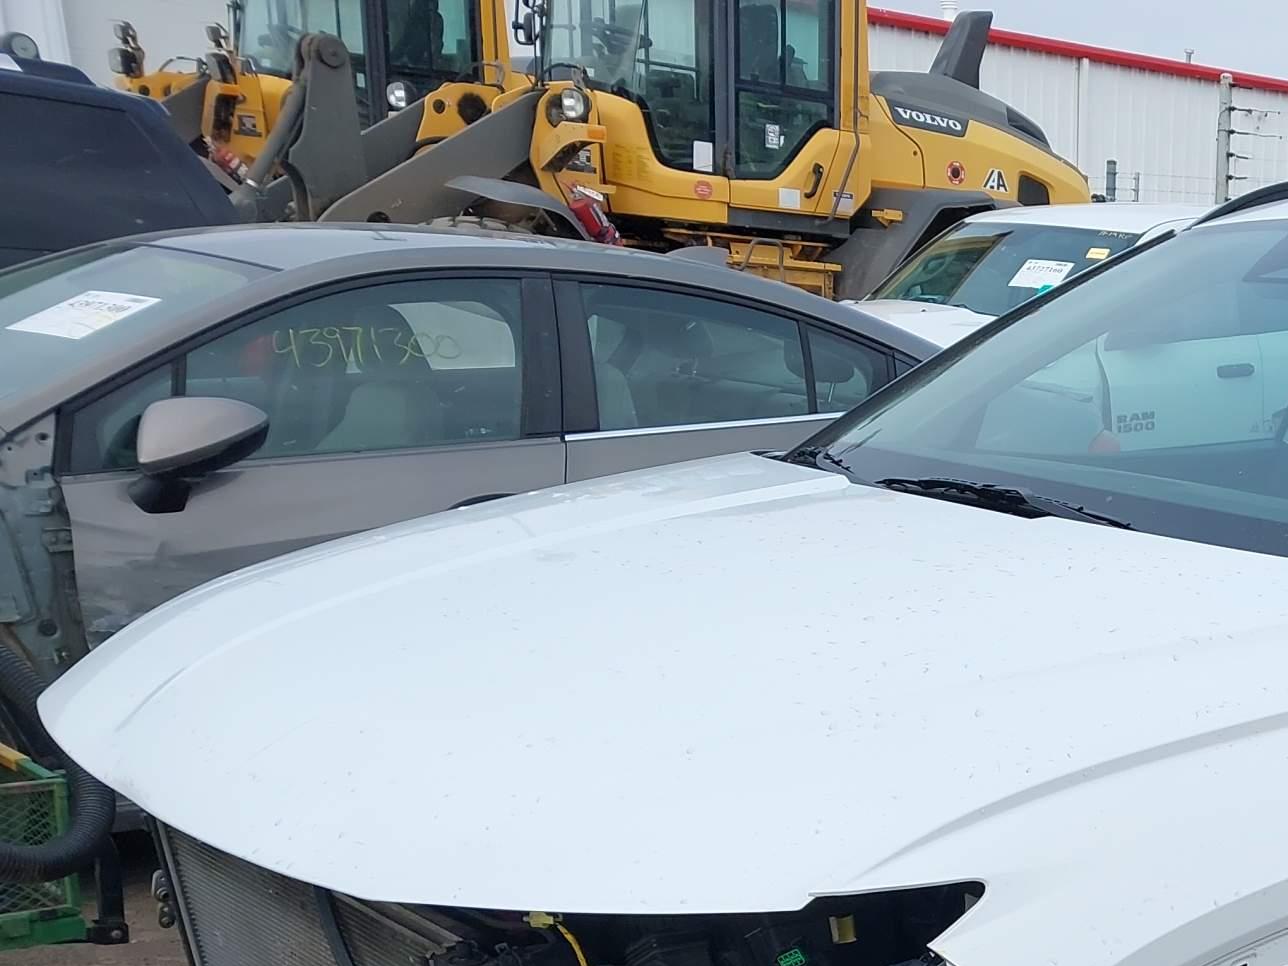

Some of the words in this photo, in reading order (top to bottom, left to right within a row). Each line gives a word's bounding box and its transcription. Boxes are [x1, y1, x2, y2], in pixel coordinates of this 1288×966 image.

[895, 106, 962, 131] VOLVO
[272, 326, 463, 368] 43971300
[1117, 411, 1155, 424] RAM
[1117, 421, 1155, 433] 1500
